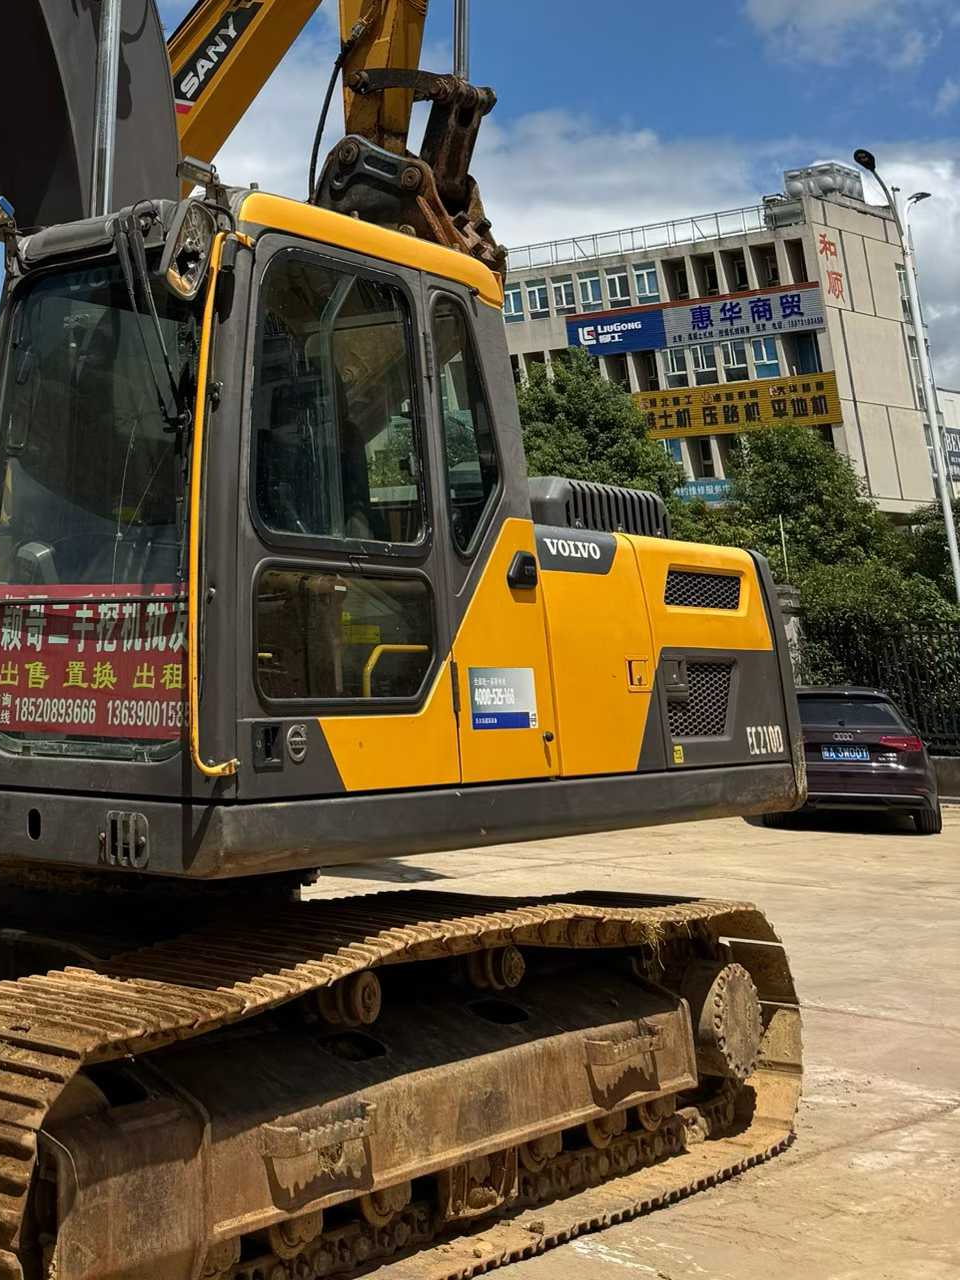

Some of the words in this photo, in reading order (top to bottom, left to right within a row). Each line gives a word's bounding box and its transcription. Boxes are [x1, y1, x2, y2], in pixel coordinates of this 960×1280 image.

[179, 15, 238, 99] SANY
[689, 293, 805, 331] 惠华商贸
[543, 537, 601, 560] VOLVO
[62, 660, 117, 690] 置换
[132, 662, 186, 690] 出租
[15, 696, 96, 724] 18520893666
[746, 724, 784, 755] EC210D
